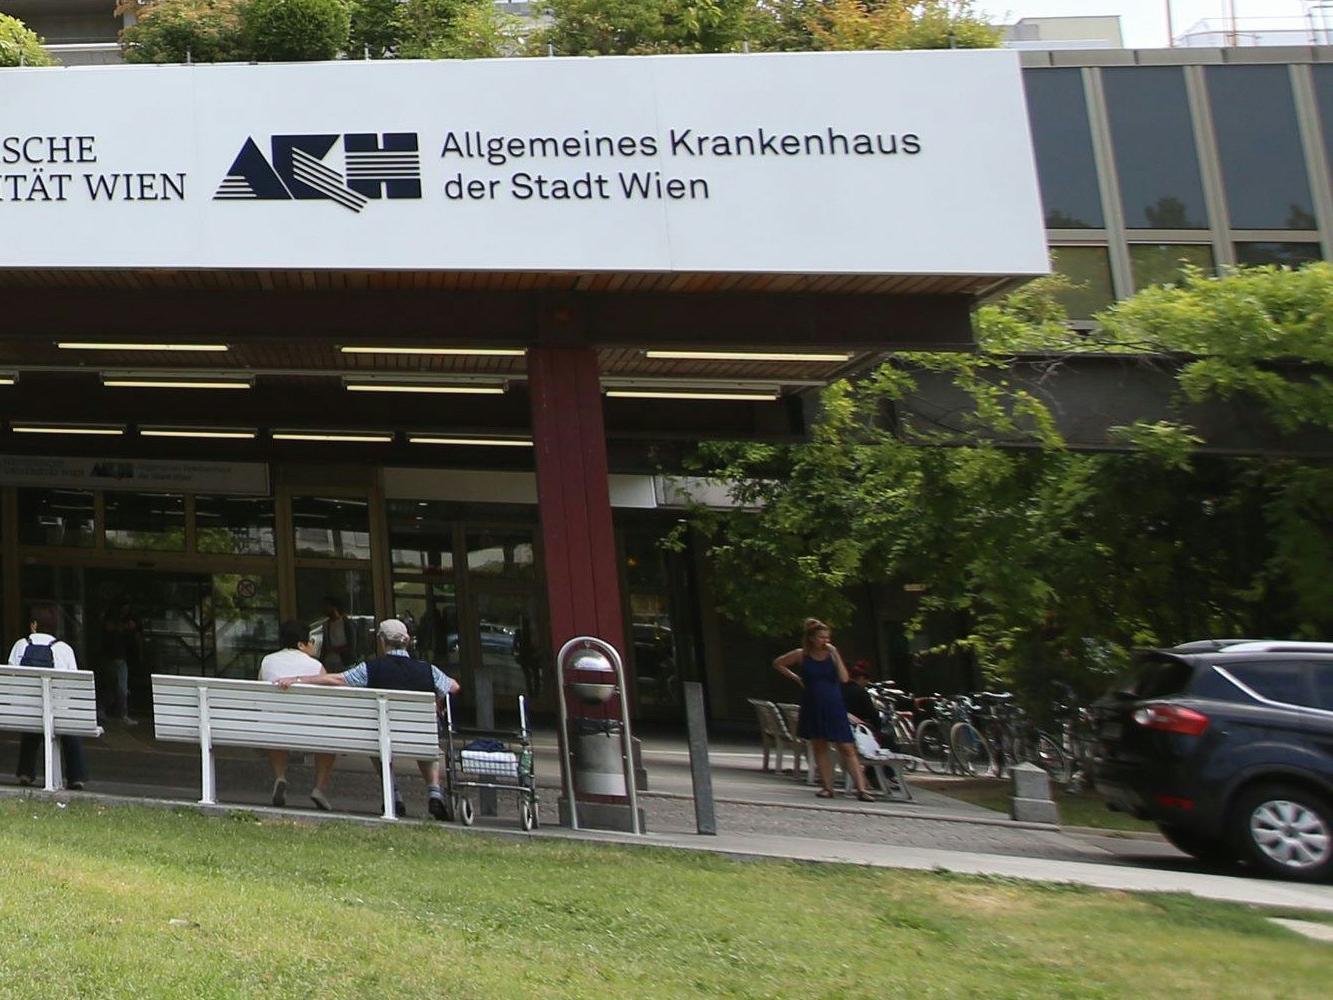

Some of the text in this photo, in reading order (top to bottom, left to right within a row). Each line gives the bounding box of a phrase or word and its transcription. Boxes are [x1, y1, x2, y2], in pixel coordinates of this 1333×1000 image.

[440, 128, 922, 165] Allgemeines Krankenhaus
[82, 172, 188, 201] WIEN
[212, 132, 423, 214] AKH
[443, 171, 709, 201] der Stadt Wien
